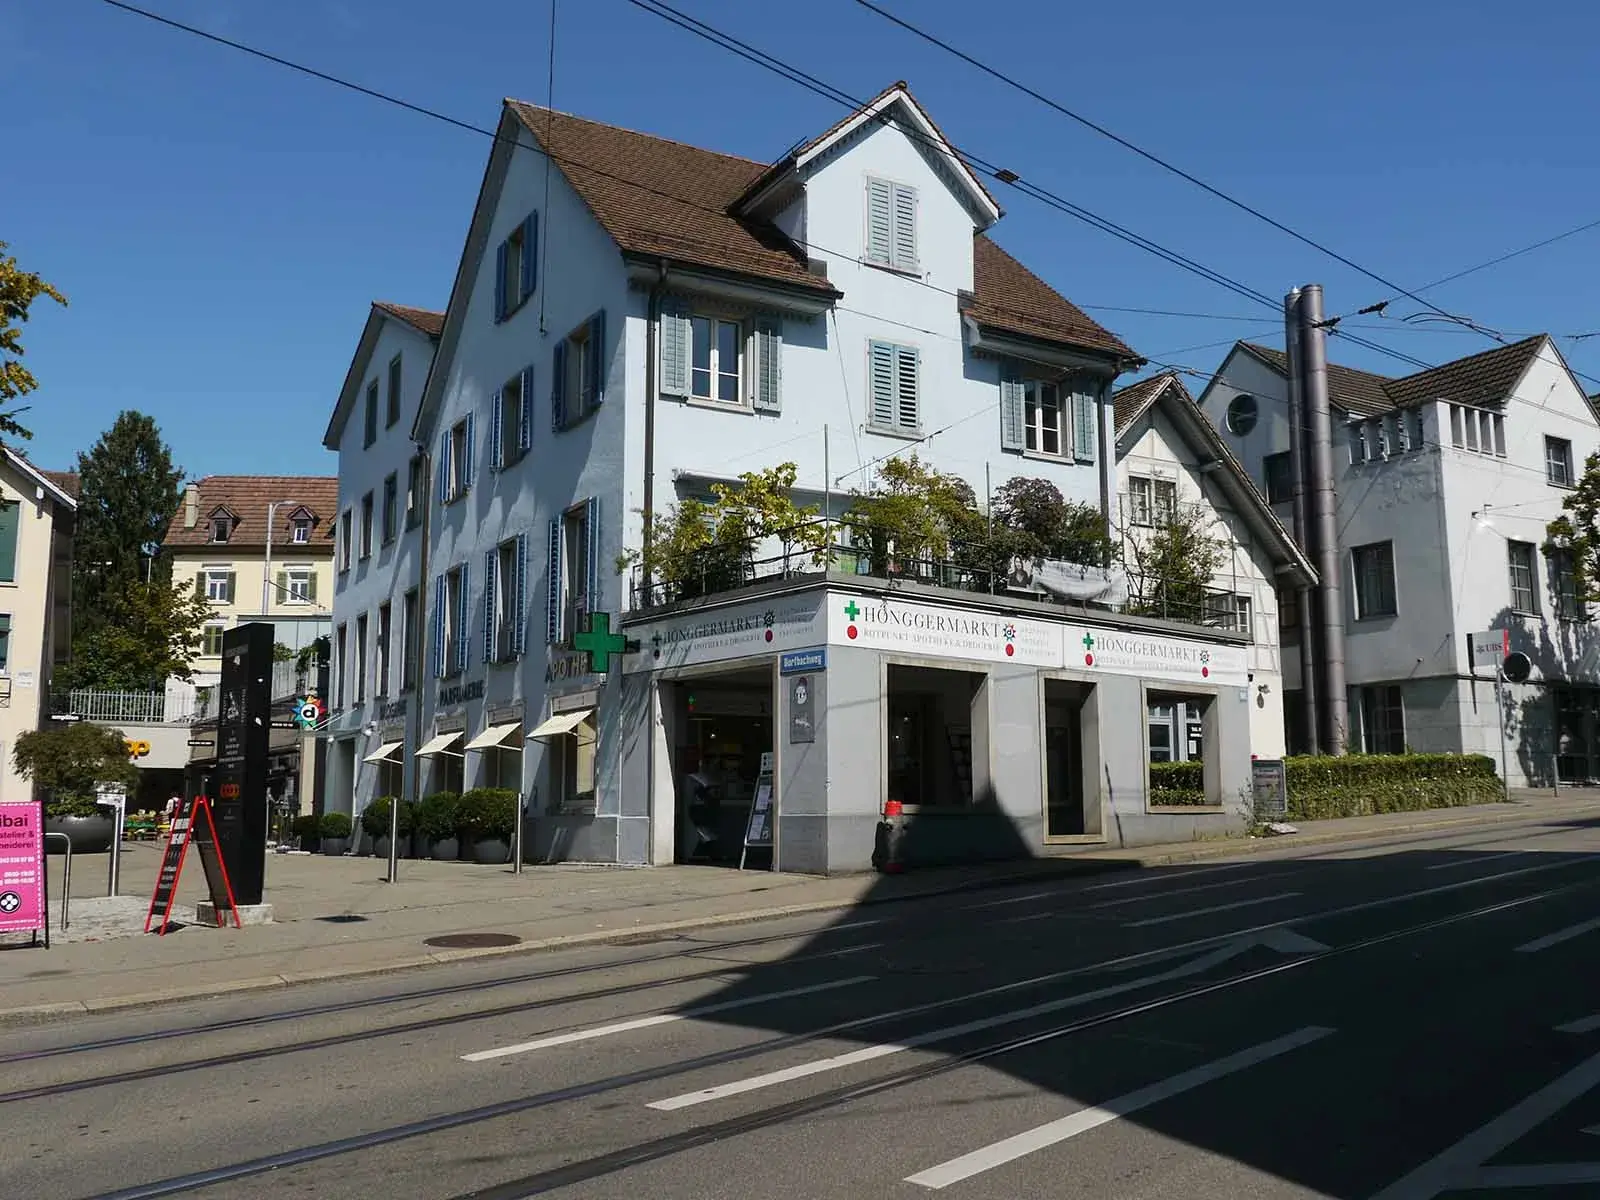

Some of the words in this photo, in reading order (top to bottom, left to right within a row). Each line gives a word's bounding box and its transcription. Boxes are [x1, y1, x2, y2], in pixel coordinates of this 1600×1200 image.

[1486, 642, 1504, 652] UBS
[545, 651, 588, 683] APOTHE
[783, 655, 822, 668] Dorfbachweg
